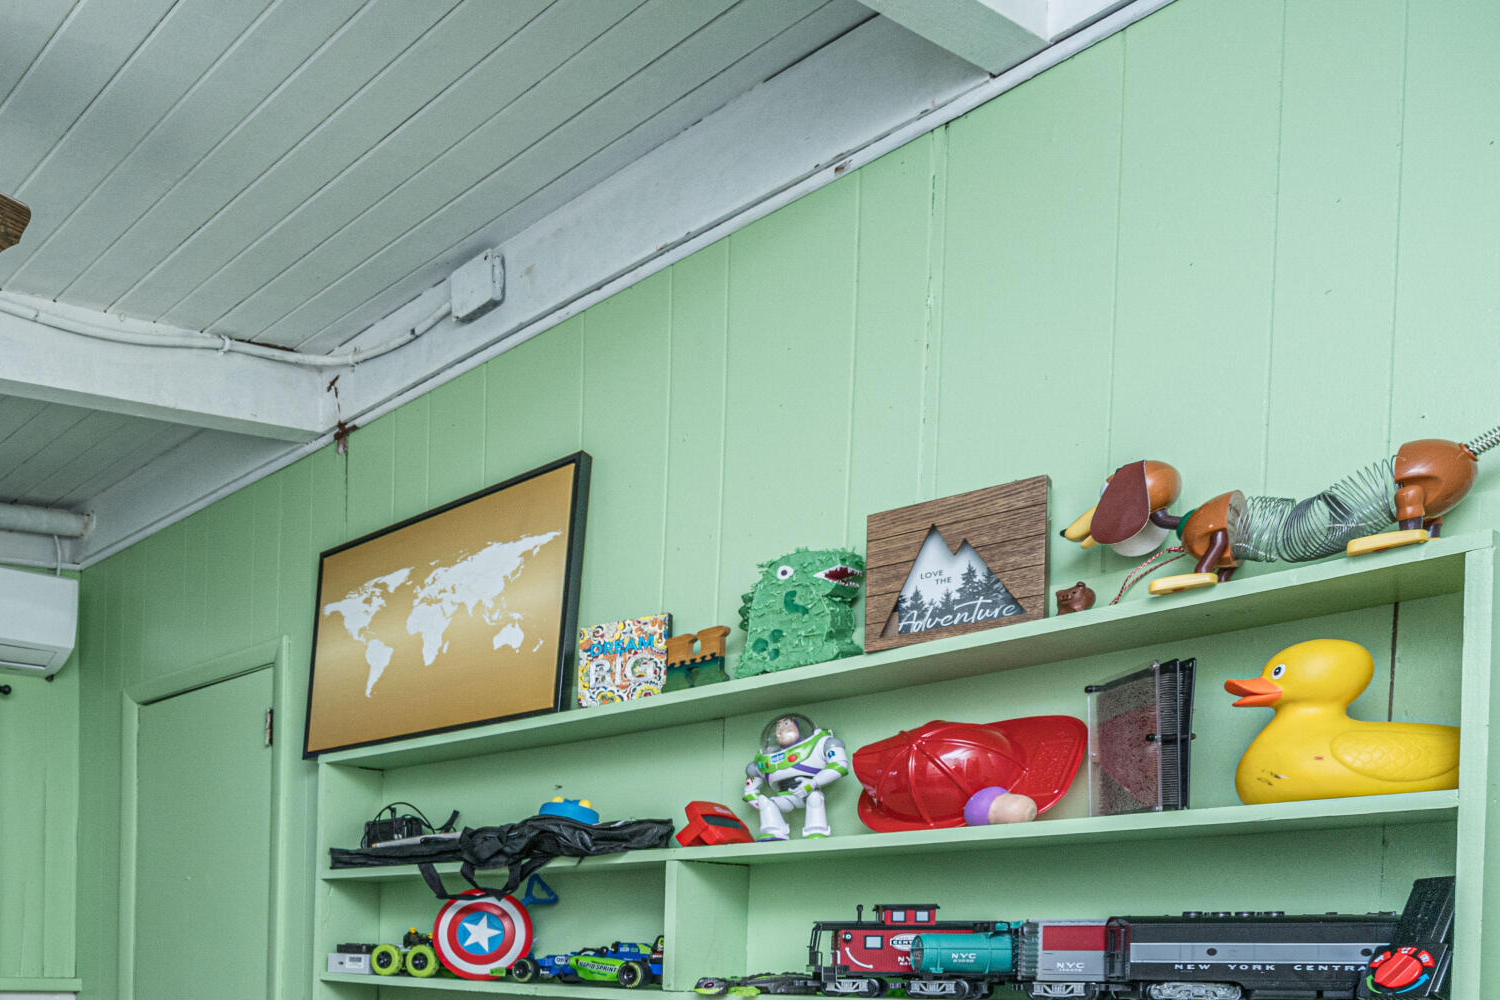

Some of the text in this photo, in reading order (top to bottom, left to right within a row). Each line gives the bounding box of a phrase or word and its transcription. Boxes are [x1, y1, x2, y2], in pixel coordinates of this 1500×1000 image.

[920, 569, 943, 580] LOVE
[936, 576, 952, 585] THE
[898, 596, 1018, 633] Adventure
[590, 634, 654, 657] DREAM
[589, 655, 655, 689] BIG
[951, 952, 977, 960] NYC
[1174, 963, 1211, 971] NEW
[1293, 964, 1367, 972] CENTRA
